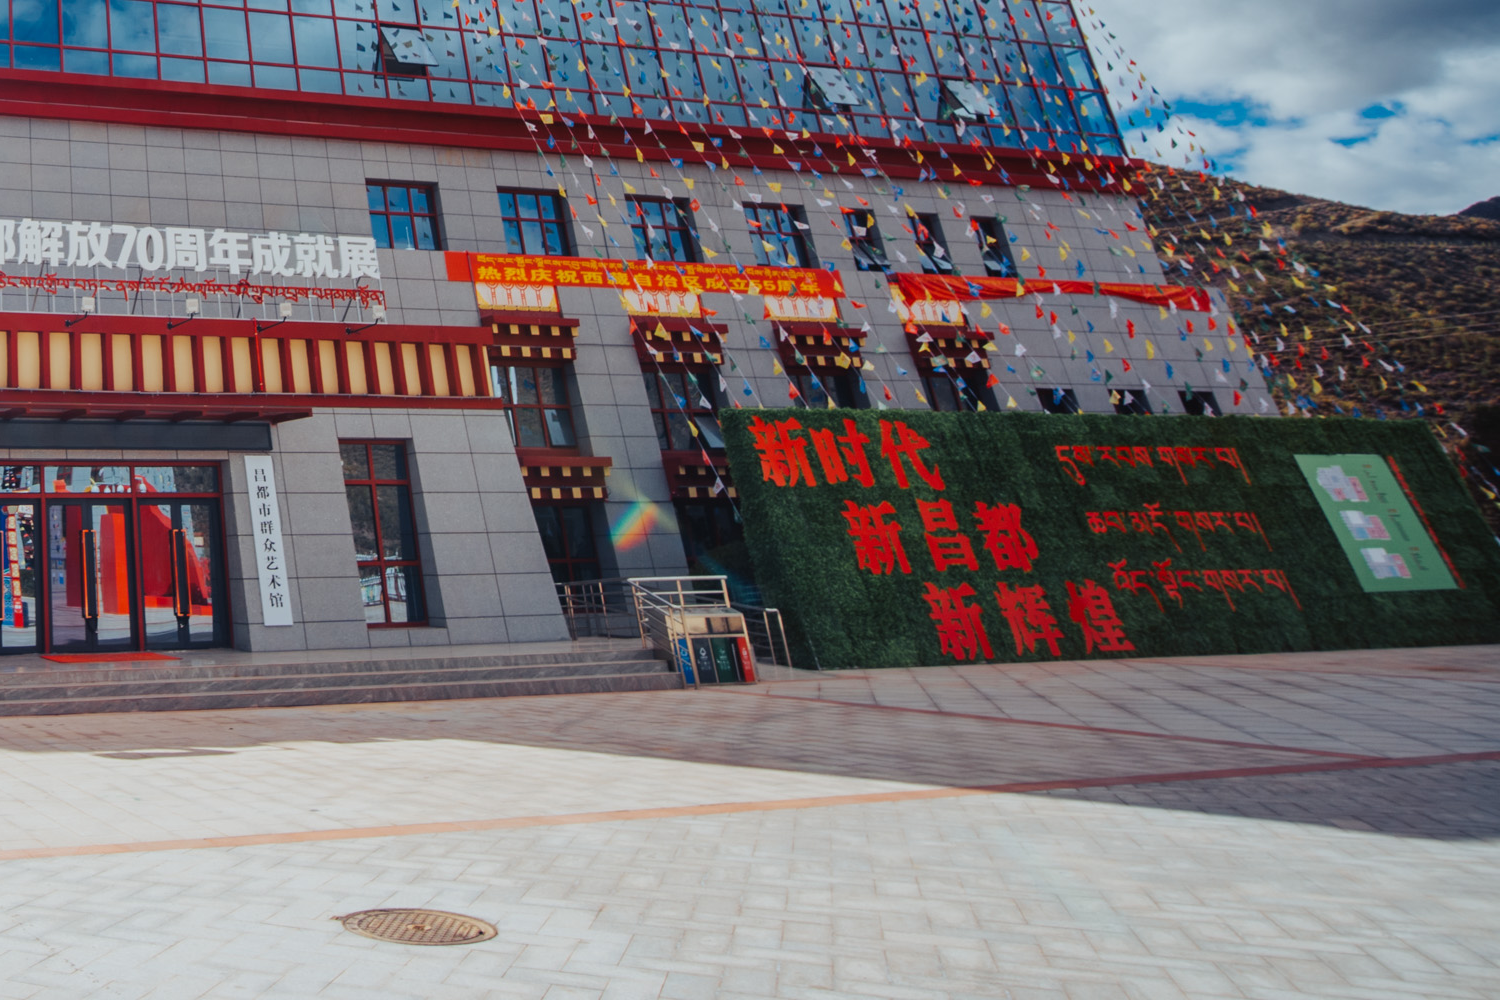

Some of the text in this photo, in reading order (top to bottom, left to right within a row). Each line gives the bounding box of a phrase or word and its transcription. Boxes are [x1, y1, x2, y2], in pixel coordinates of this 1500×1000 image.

[477, 265, 821, 293] 热烈庆祝西藏自治区成立55周年
[747, 415, 946, 491] 新时代
[254, 468, 284, 608] 昌都市群众艺术馆
[840, 498, 1040, 575] 新昌都
[922, 579, 1136, 660] 新辉煌
